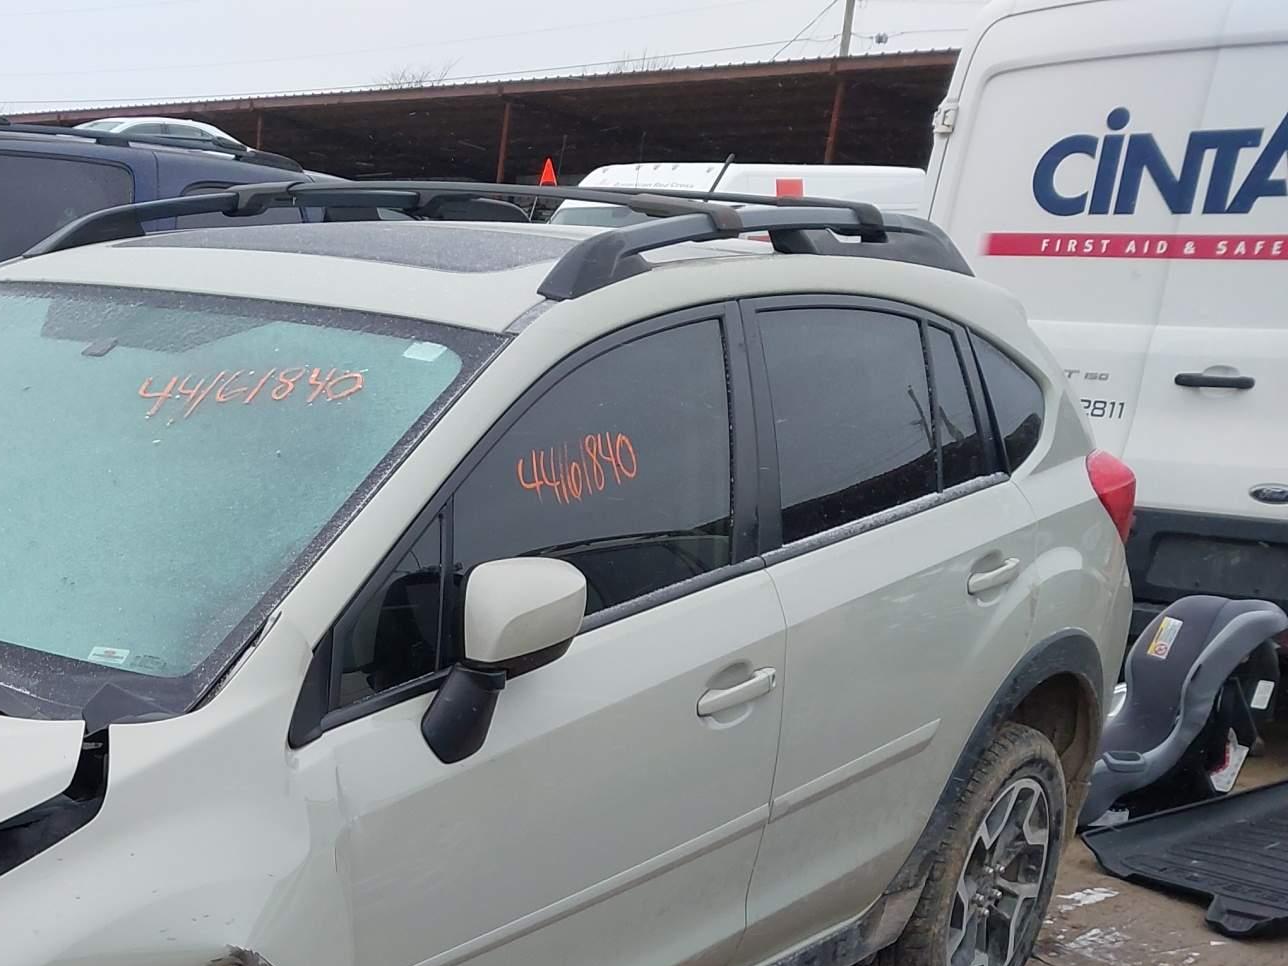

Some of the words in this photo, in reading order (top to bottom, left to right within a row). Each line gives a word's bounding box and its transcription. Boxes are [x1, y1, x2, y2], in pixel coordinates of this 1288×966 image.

[1041, 238, 1111, 253] FIRST
[1125, 239, 1169, 254] AID
[1183, 241, 1197, 256] &
[1216, 240, 1284, 256] SAFE
[138, 368, 365, 418] 44161840
